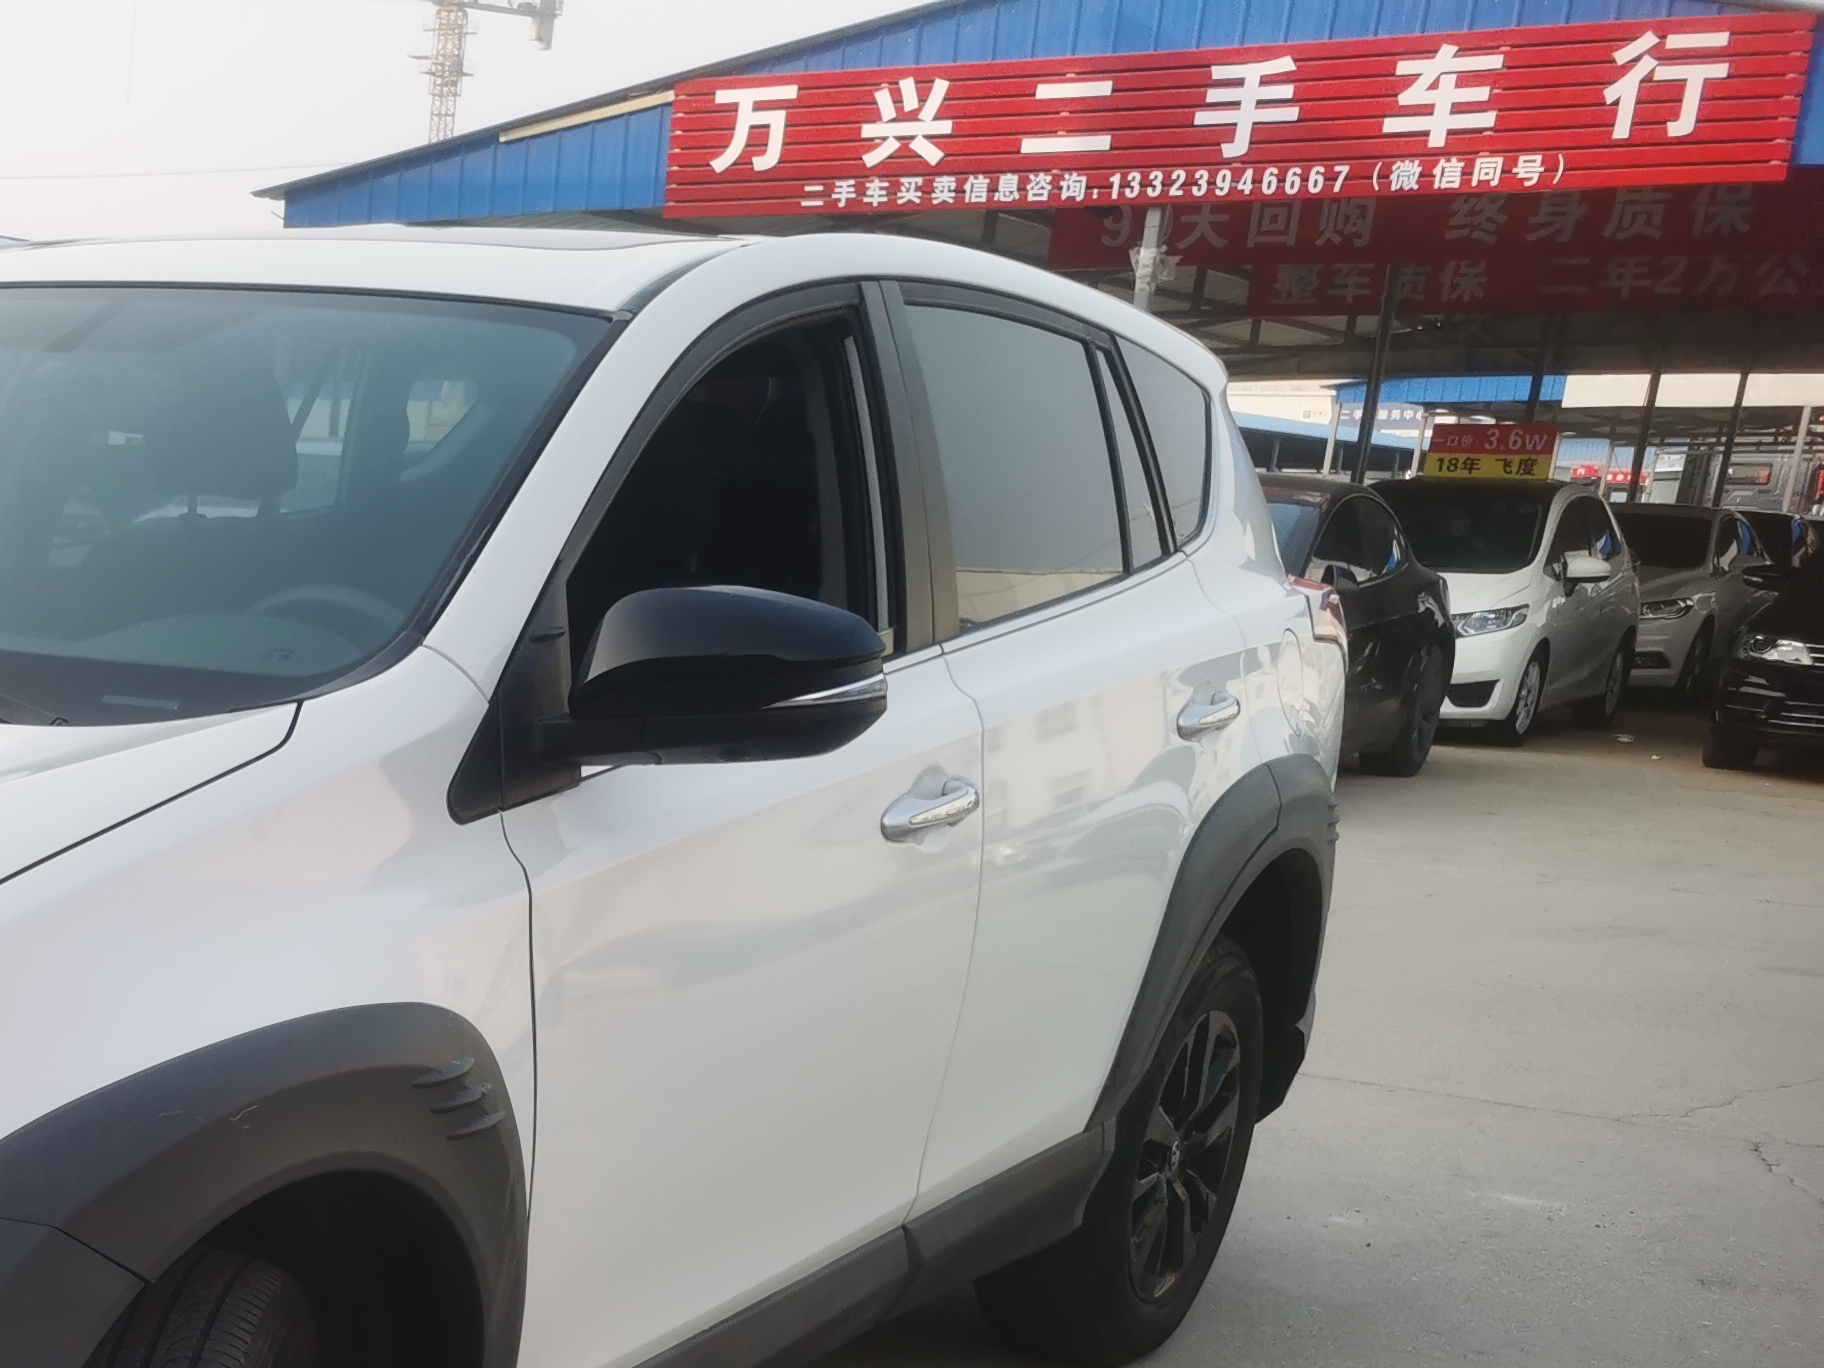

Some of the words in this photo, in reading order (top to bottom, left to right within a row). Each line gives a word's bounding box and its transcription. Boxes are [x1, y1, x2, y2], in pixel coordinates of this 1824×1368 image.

[709, 29, 1732, 173] 万兴二手车行
[1528, 250, 1824, 300] 二年2万公
[1436, 456, 1481, 475] 18年
[1494, 456, 1538, 476] 飞度
